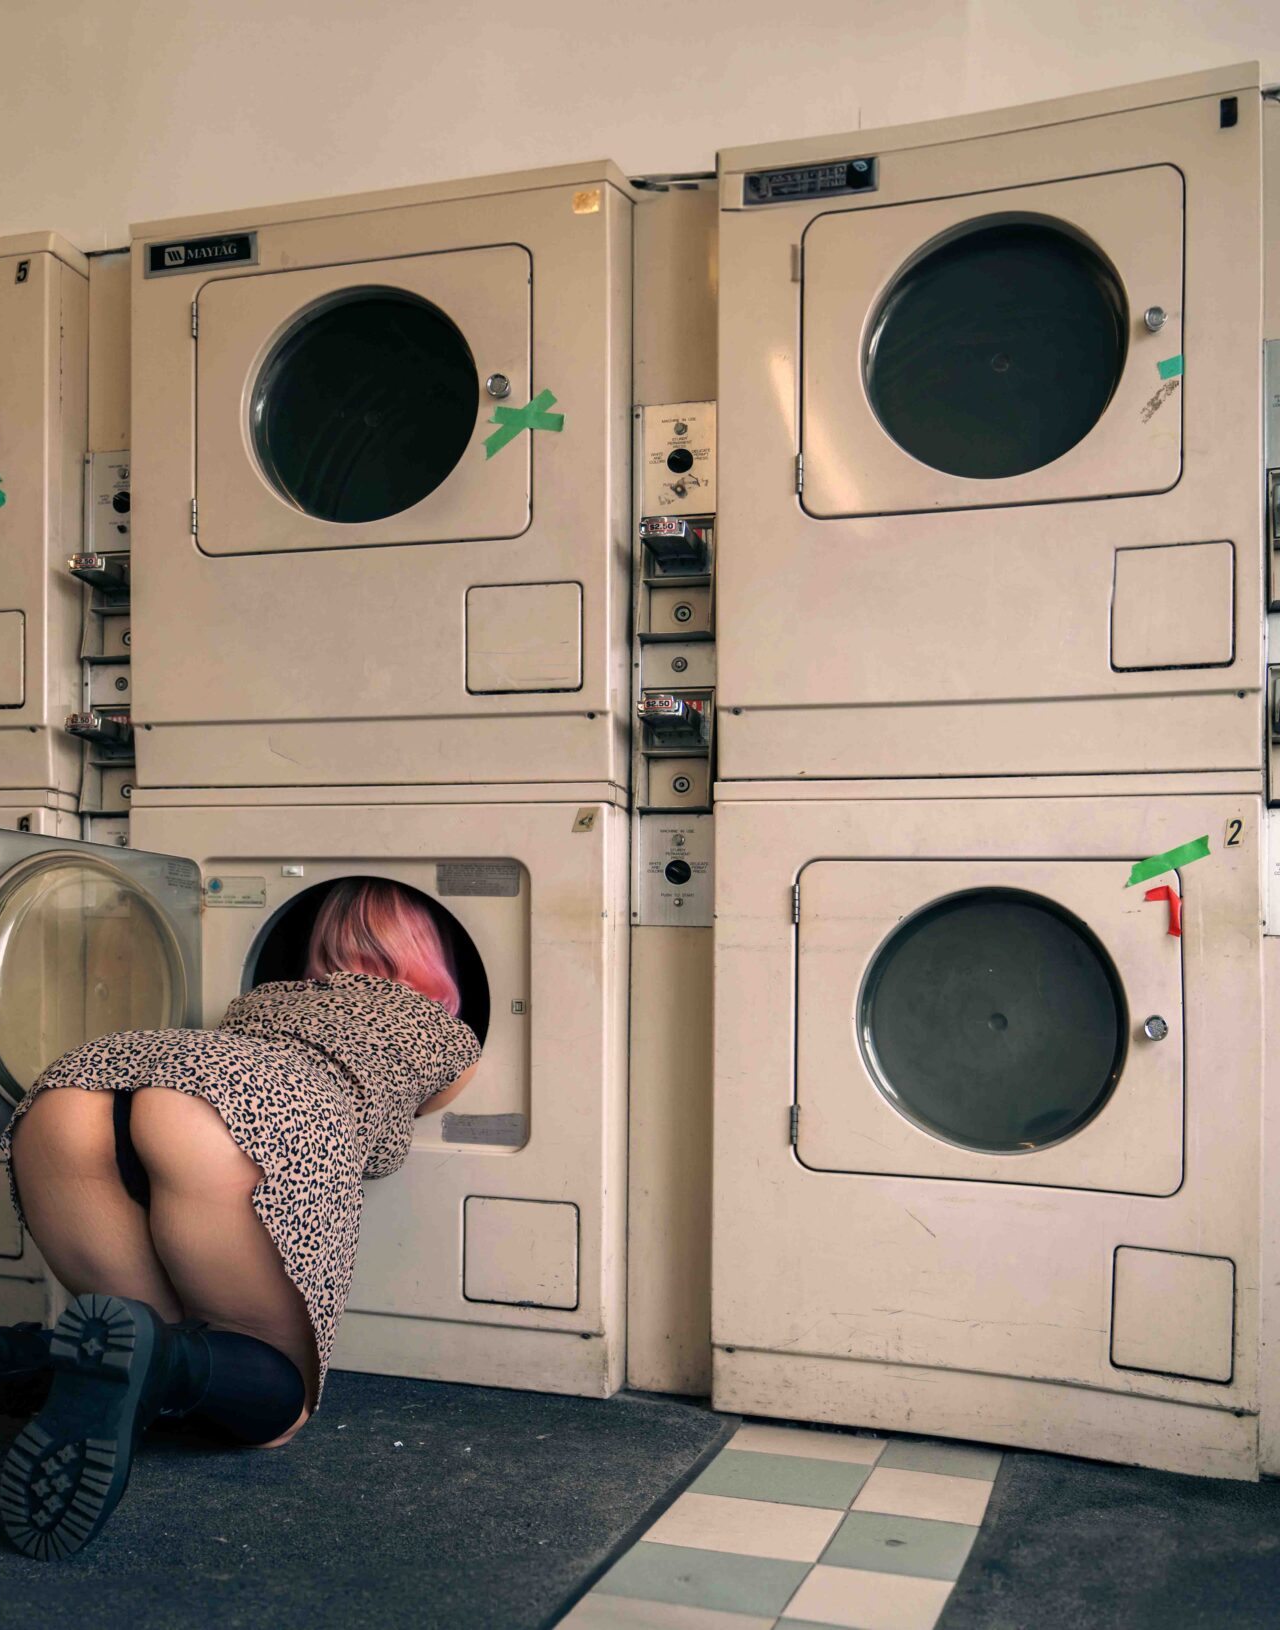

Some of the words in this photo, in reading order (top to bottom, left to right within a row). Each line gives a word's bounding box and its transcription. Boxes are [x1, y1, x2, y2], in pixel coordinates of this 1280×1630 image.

[187, 243, 237, 259] MAYTAG
[17, 261, 28, 282] 5
[1227, 819, 1242, 845] 2
